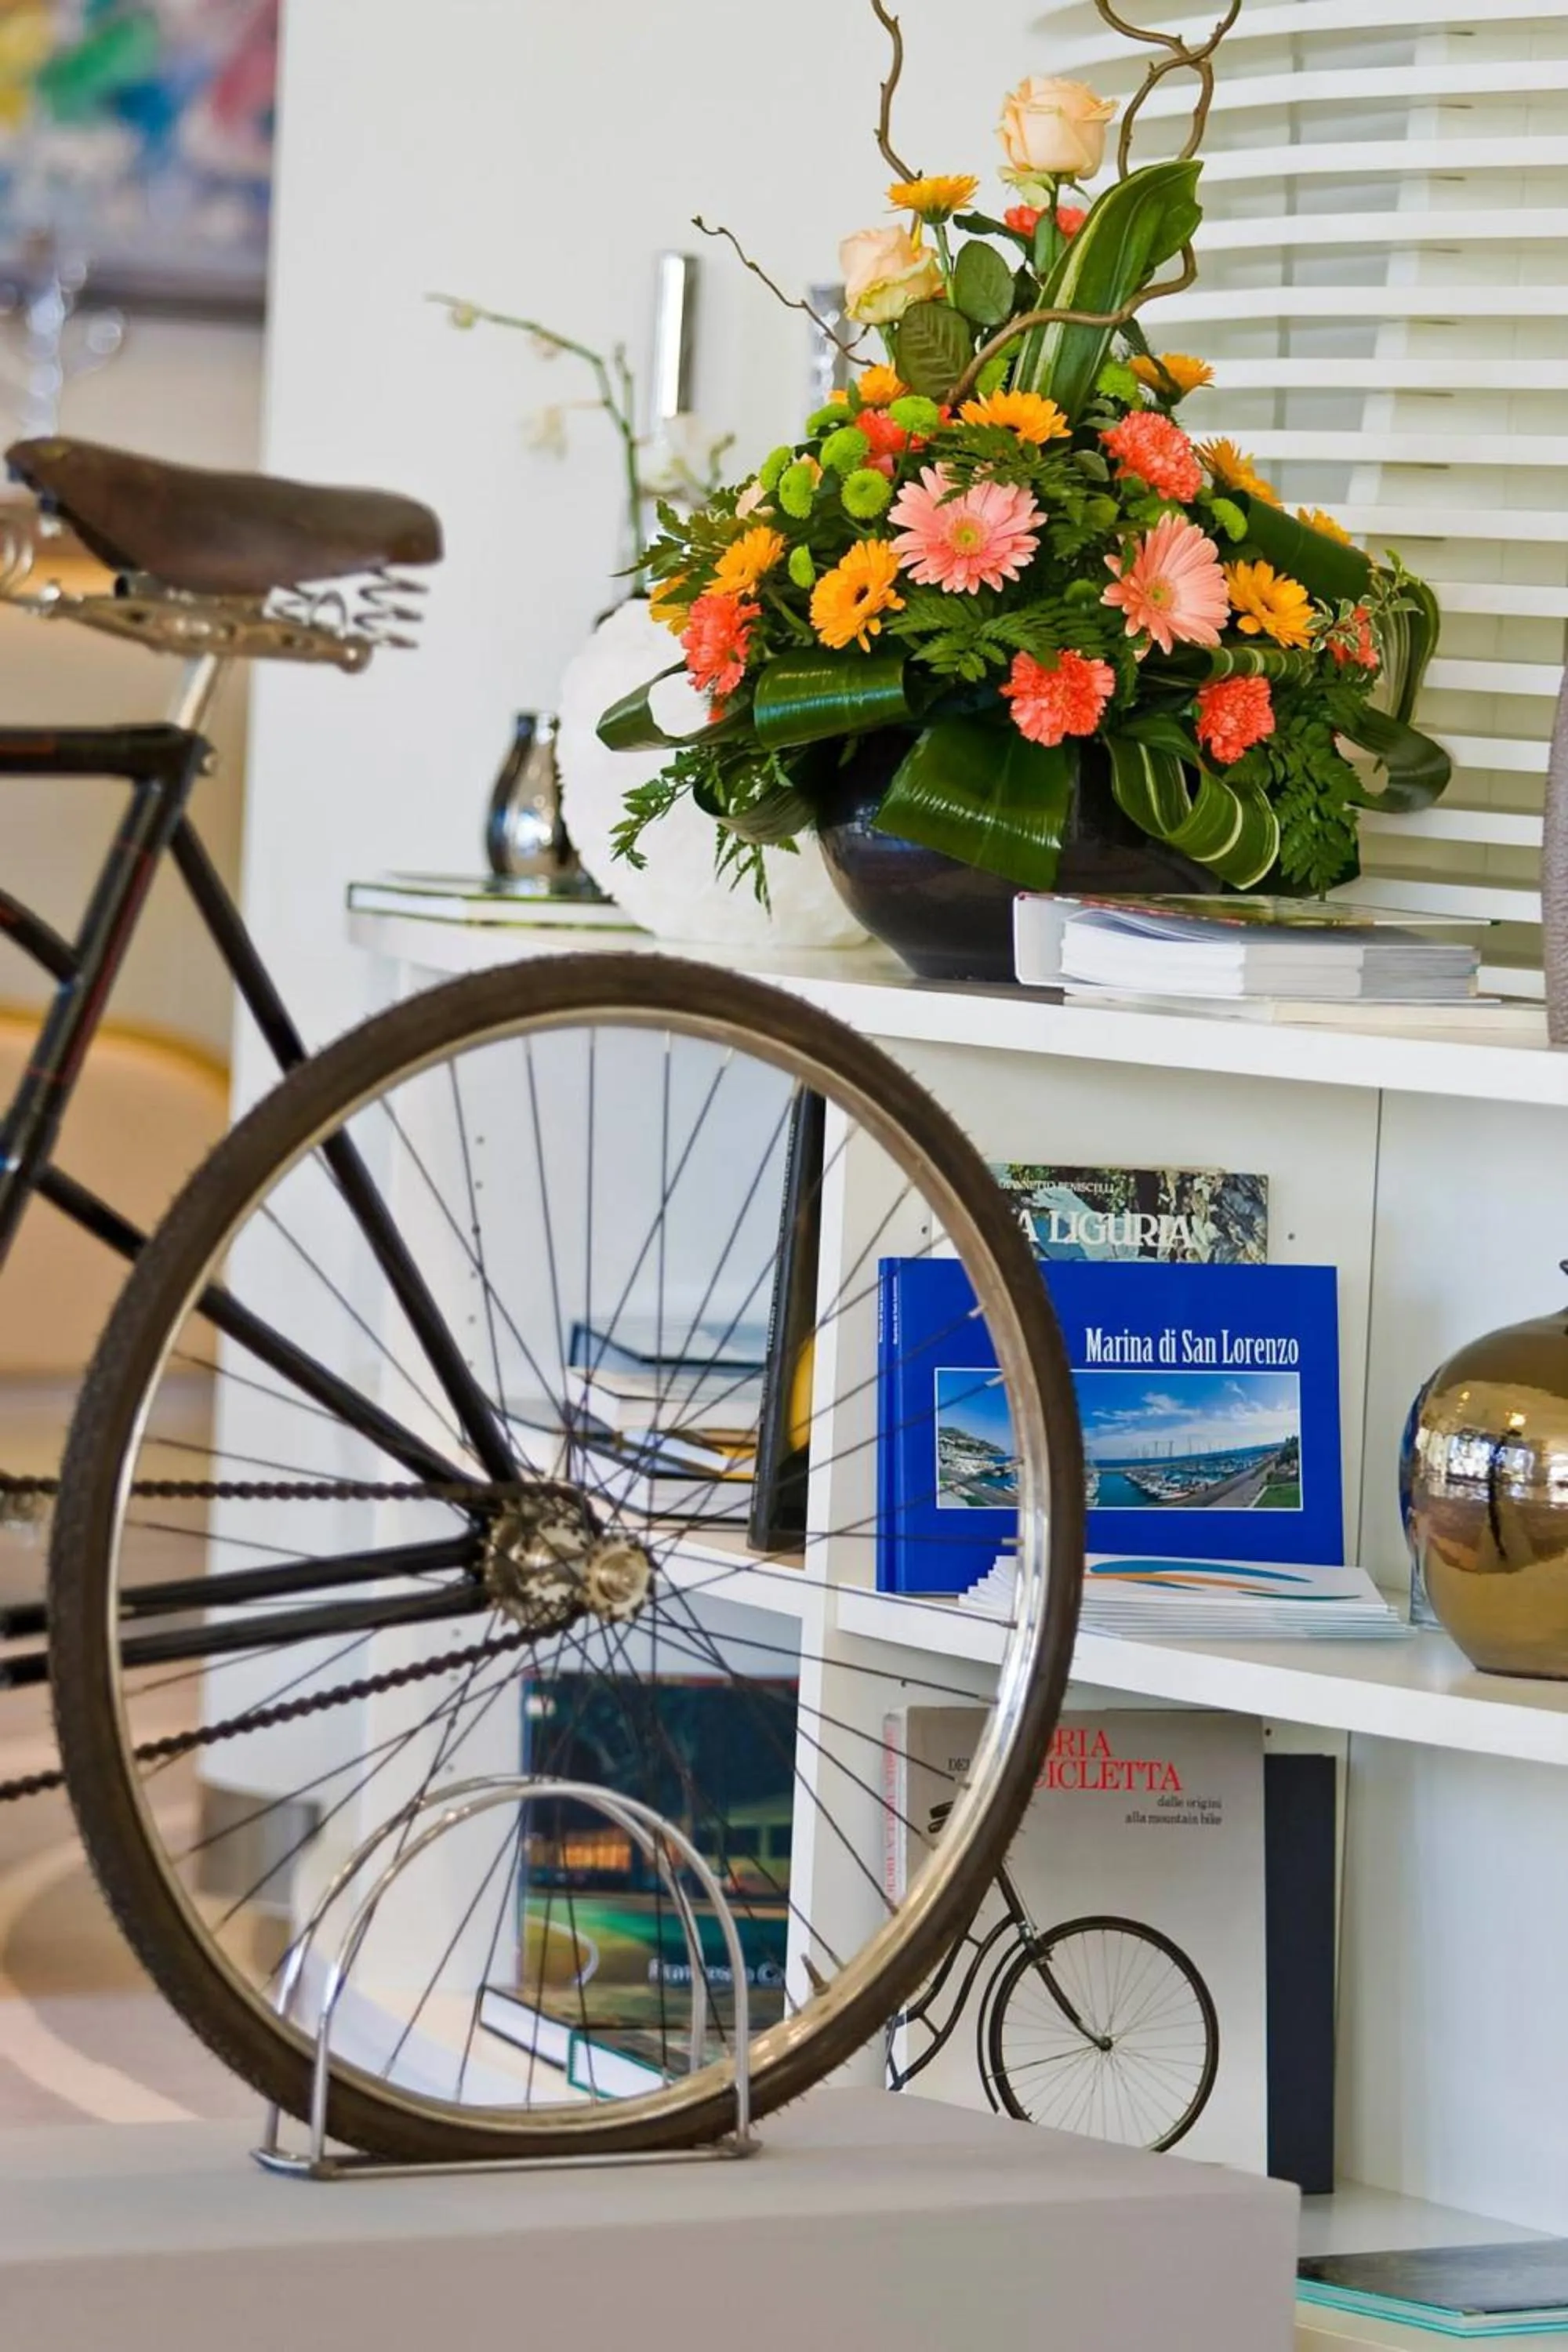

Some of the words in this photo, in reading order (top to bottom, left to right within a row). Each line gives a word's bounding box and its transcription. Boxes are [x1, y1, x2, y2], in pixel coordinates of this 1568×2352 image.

[1049, 1209, 1194, 1248] LIGURIA
[1085, 1327, 1153, 1363] Marina
[1159, 1329, 1177, 1363] di
[1181, 1329, 1217, 1364] San
[1221, 1329, 1299, 1365] Lorenzo
[1047, 1728, 1112, 1757] RIA
[1033, 1759, 1183, 1791] ICLETTA
